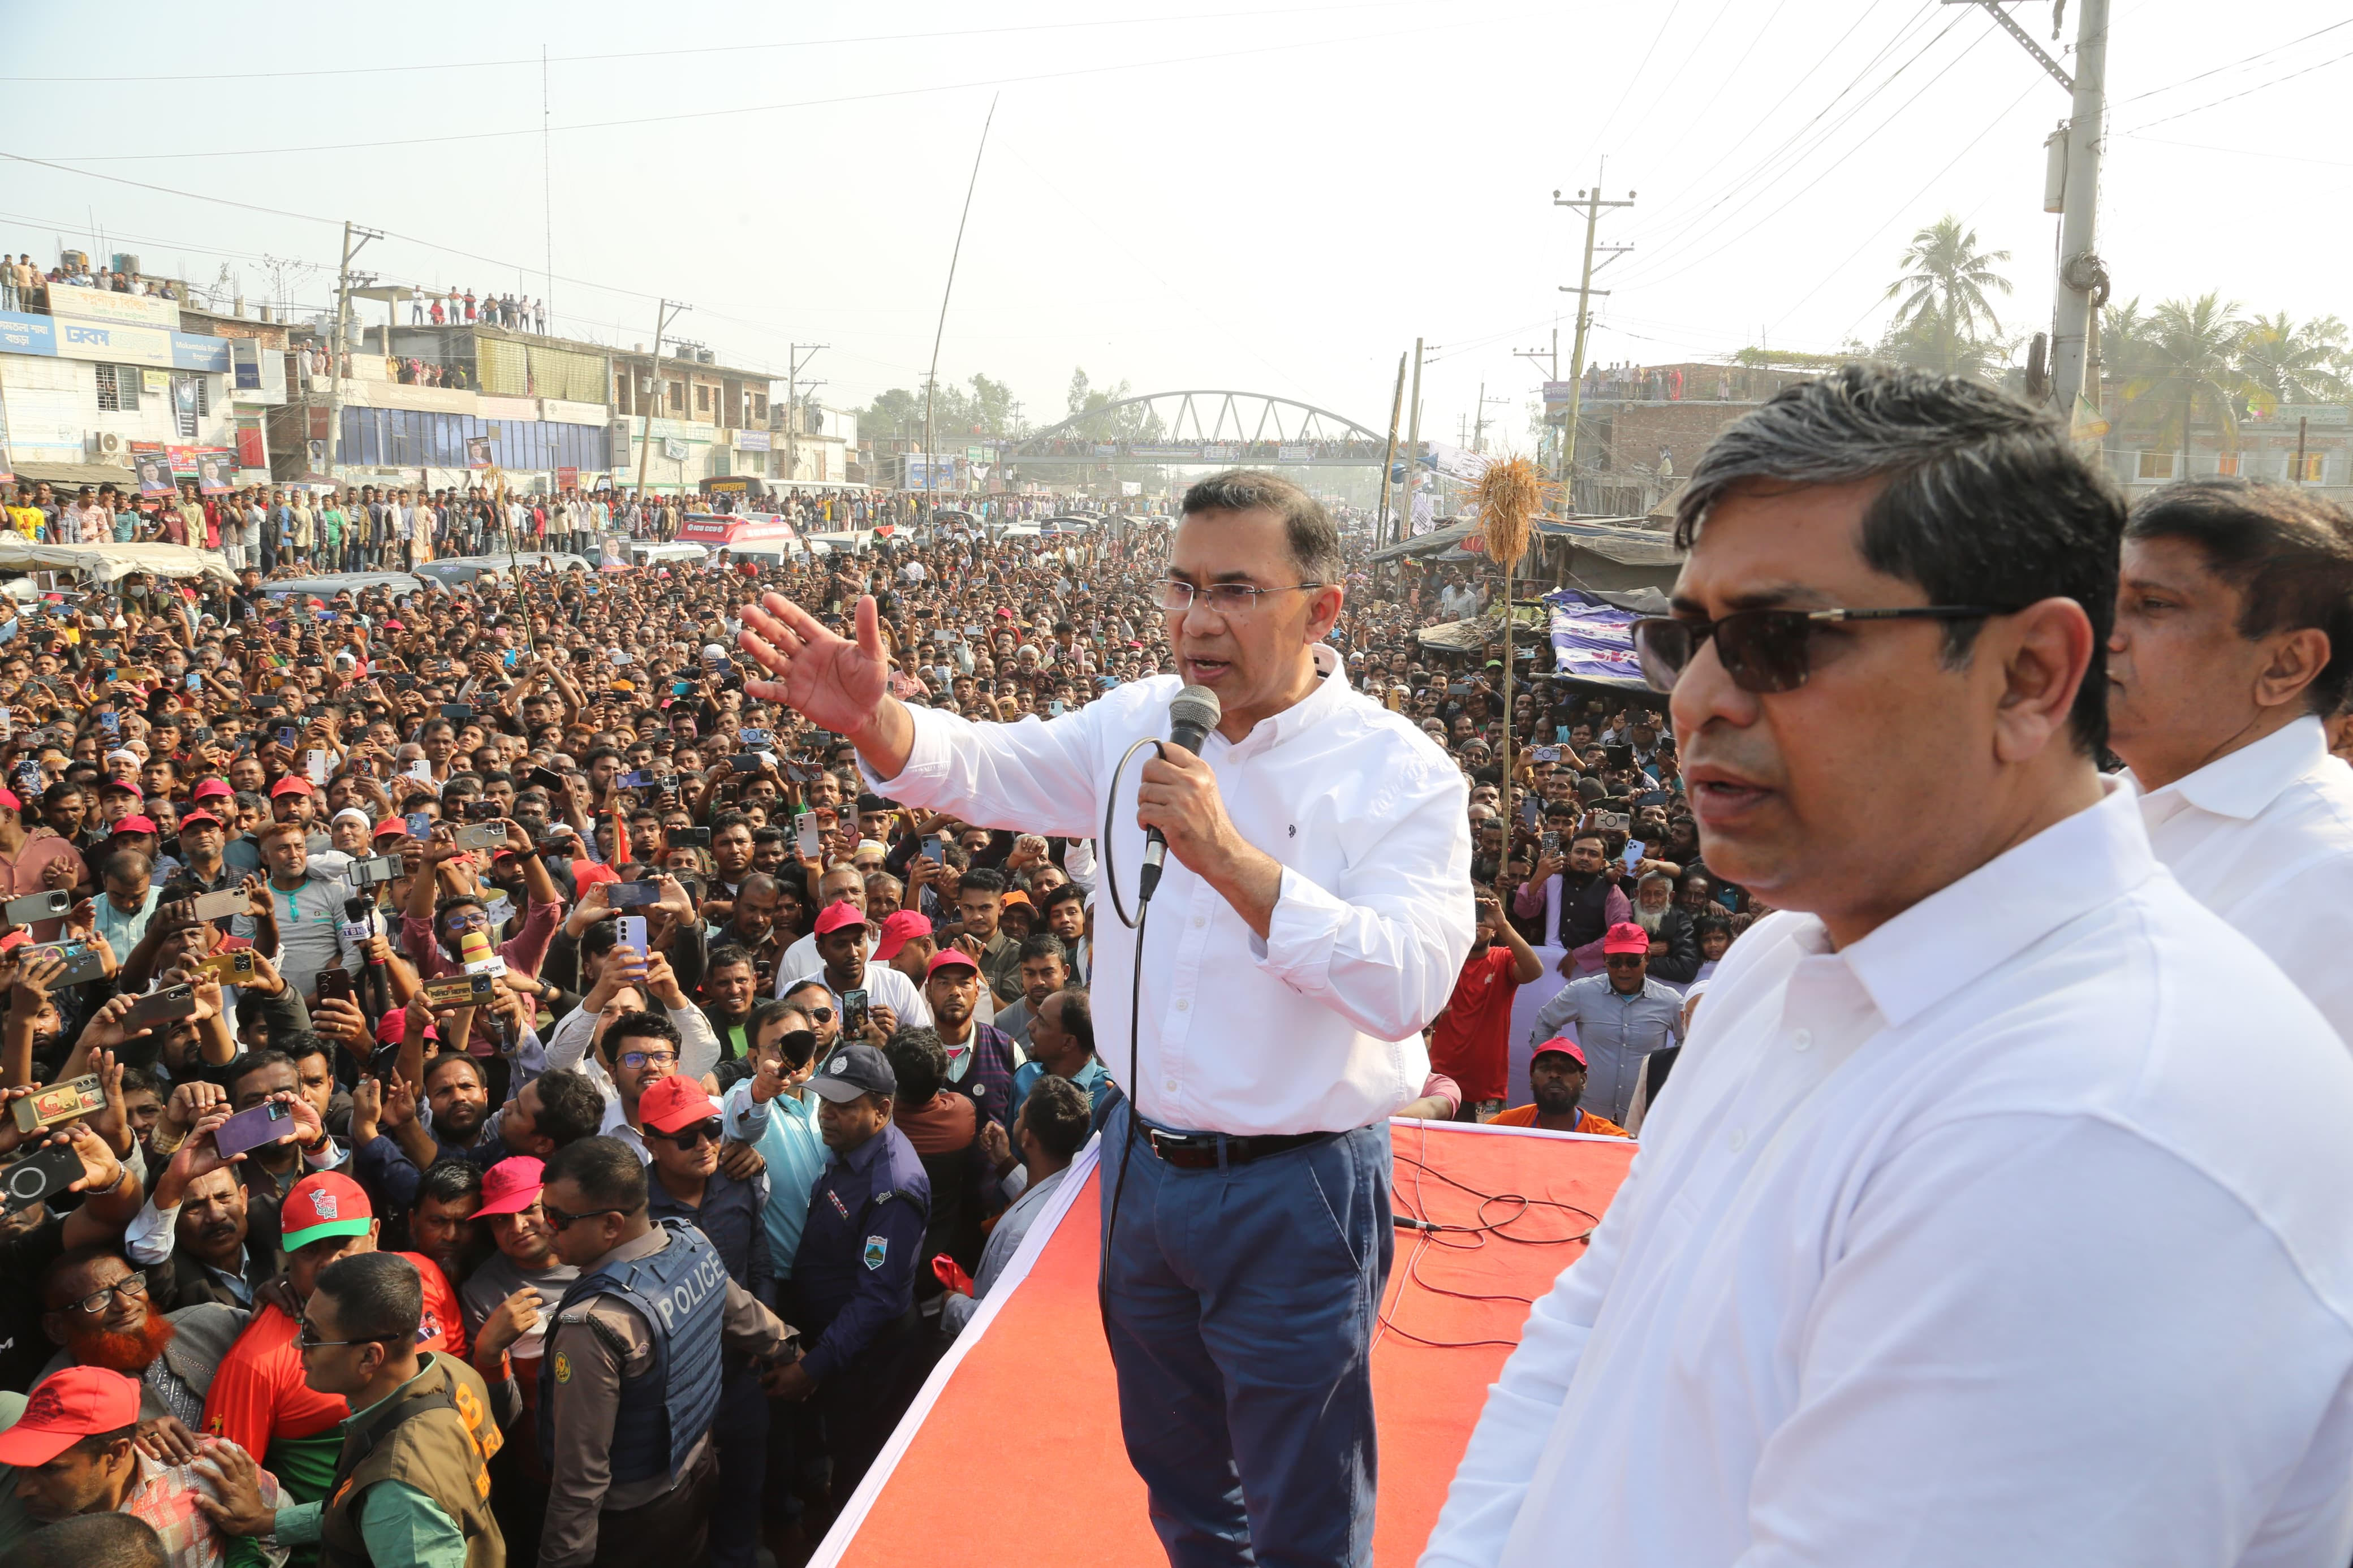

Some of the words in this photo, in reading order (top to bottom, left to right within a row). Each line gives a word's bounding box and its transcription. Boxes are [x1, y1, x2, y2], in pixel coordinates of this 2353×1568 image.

[5, 334, 29, 345] বগুড়া
[64, 325, 110, 346] ঢাকা
[176, 341, 207, 351] Mokamtola
[658, 1250, 725, 1329] POLICE
